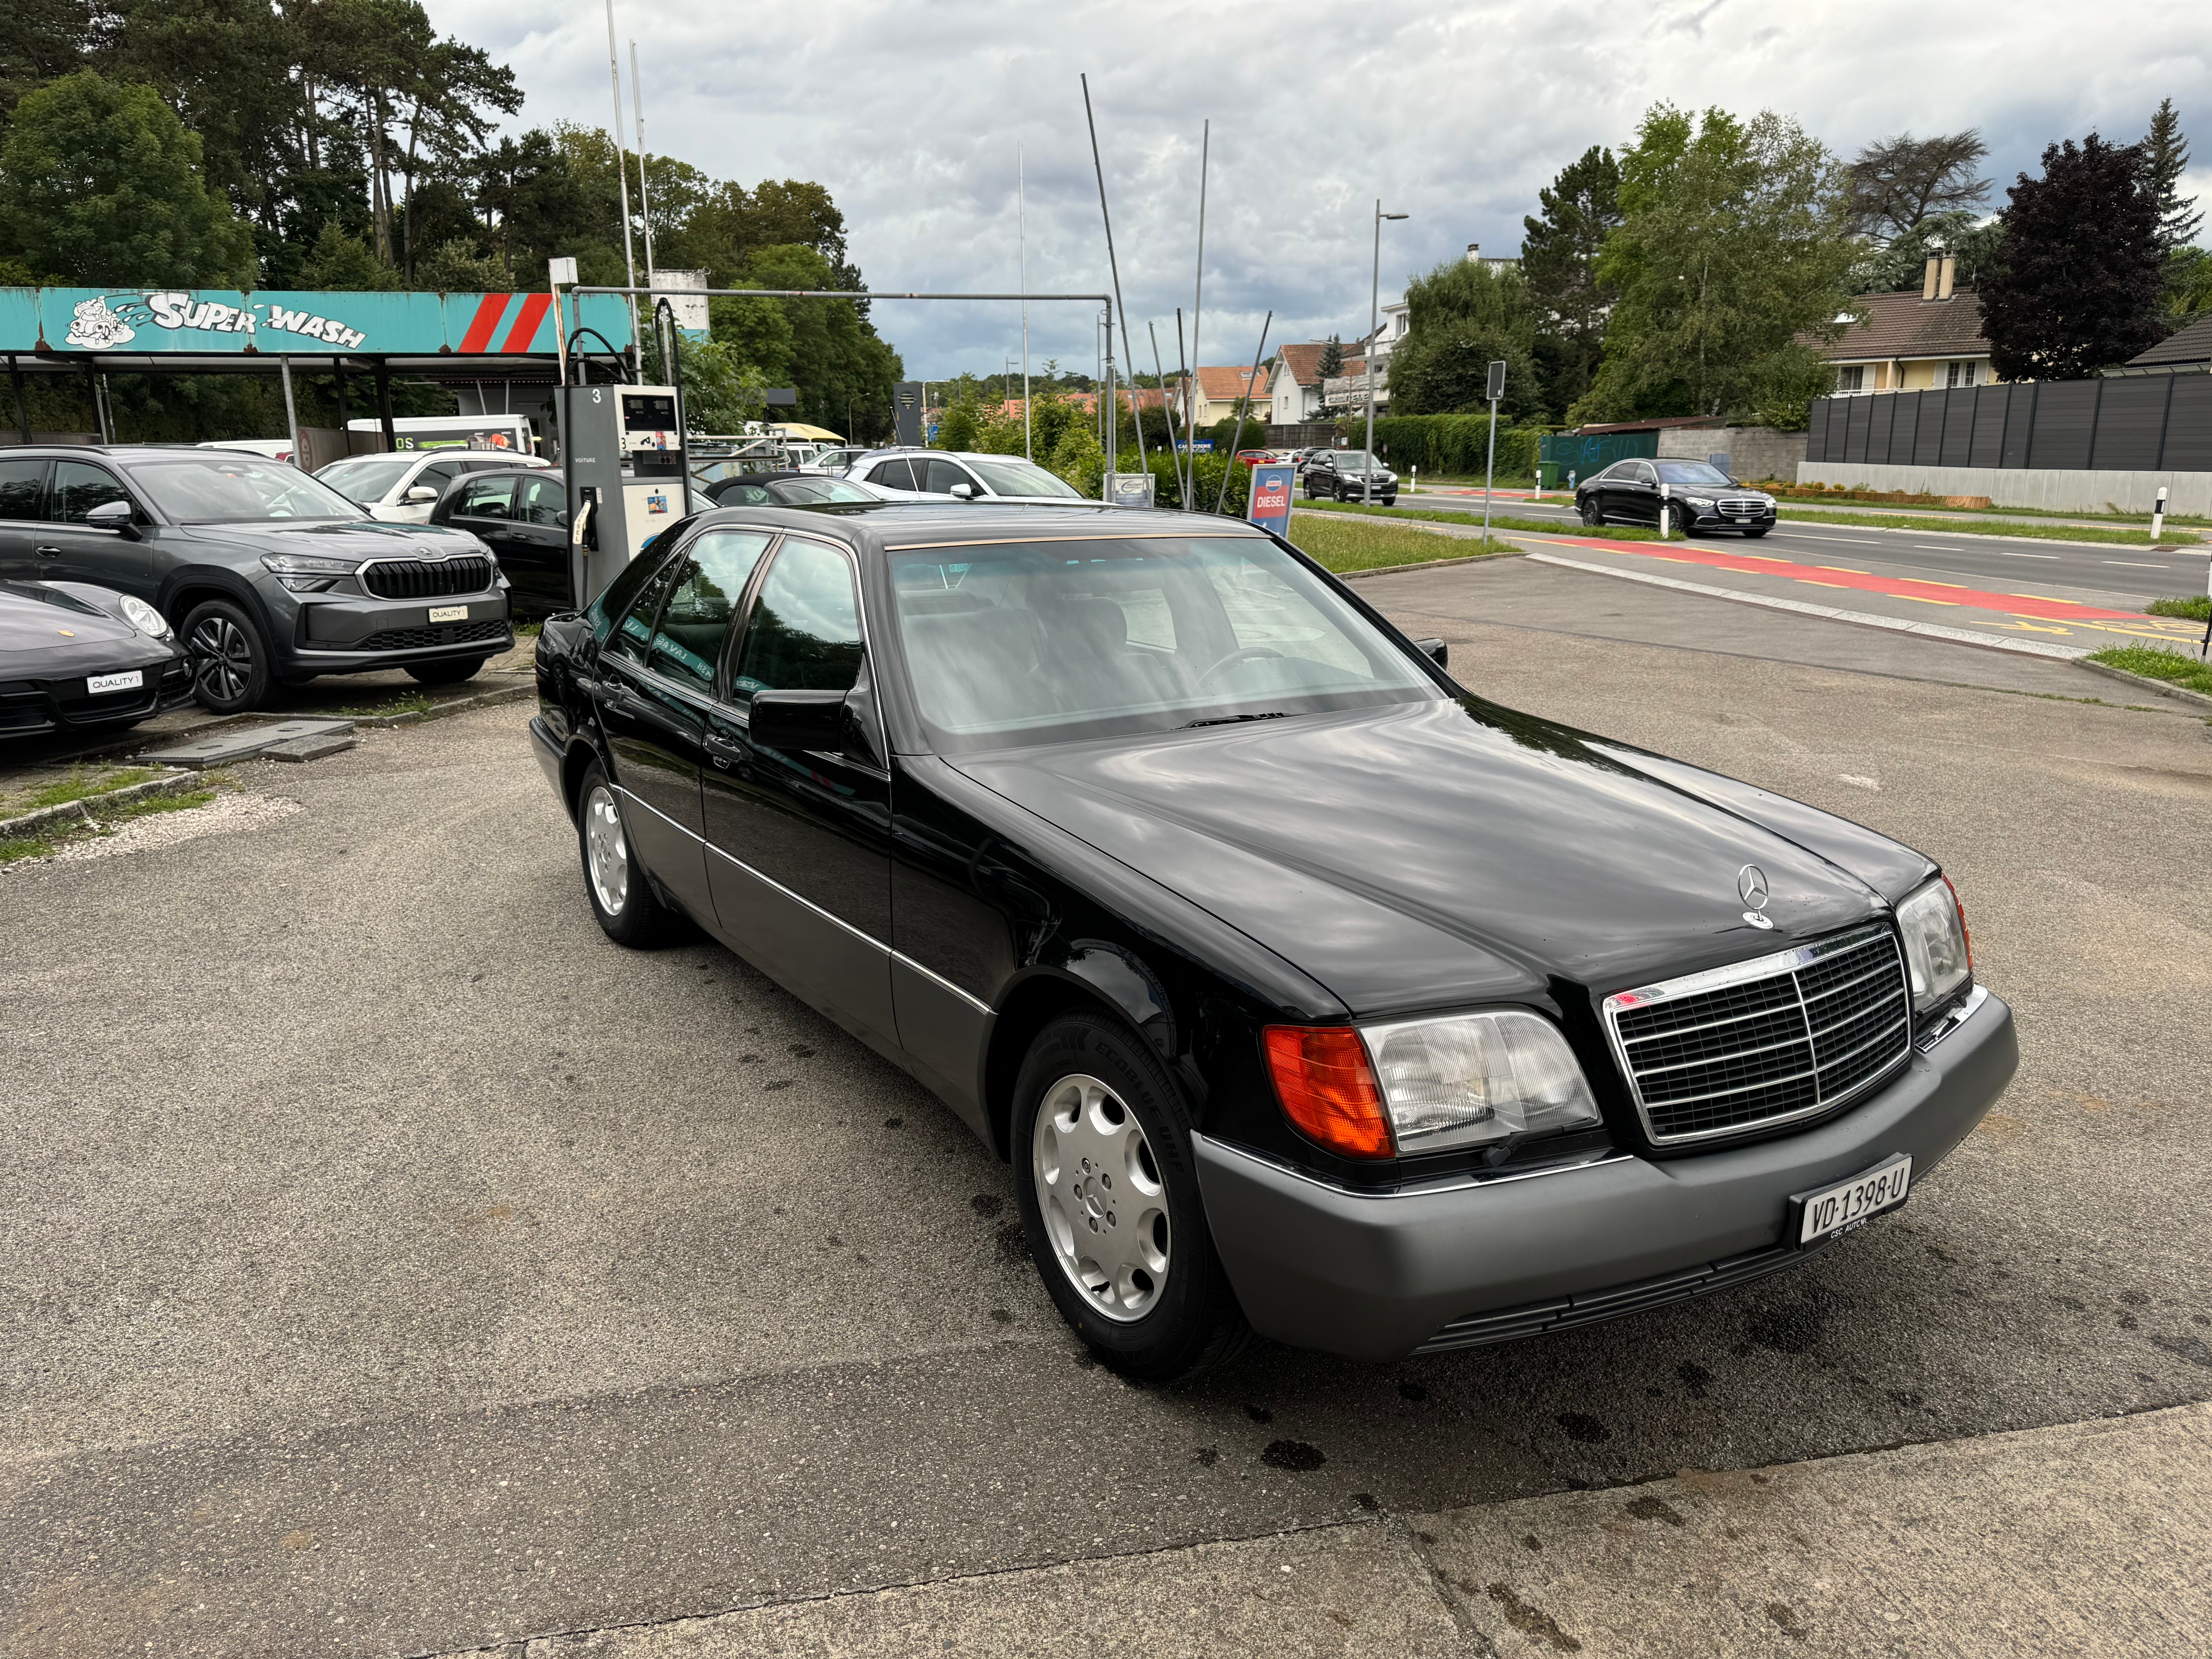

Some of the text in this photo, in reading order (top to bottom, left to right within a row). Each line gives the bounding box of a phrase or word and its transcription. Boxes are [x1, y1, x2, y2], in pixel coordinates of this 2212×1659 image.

[146, 292, 367, 350] SUPER WASH
[592, 388, 601, 403] 3
[621, 438, 626, 449] 3
[1257, 496, 1286, 508] DIESEL
[93, 677, 133, 688] QUALITY
[1094, 1041, 1184, 1174] ECOBLUE UHP
[1831, 1228, 1843, 1238] CSC
